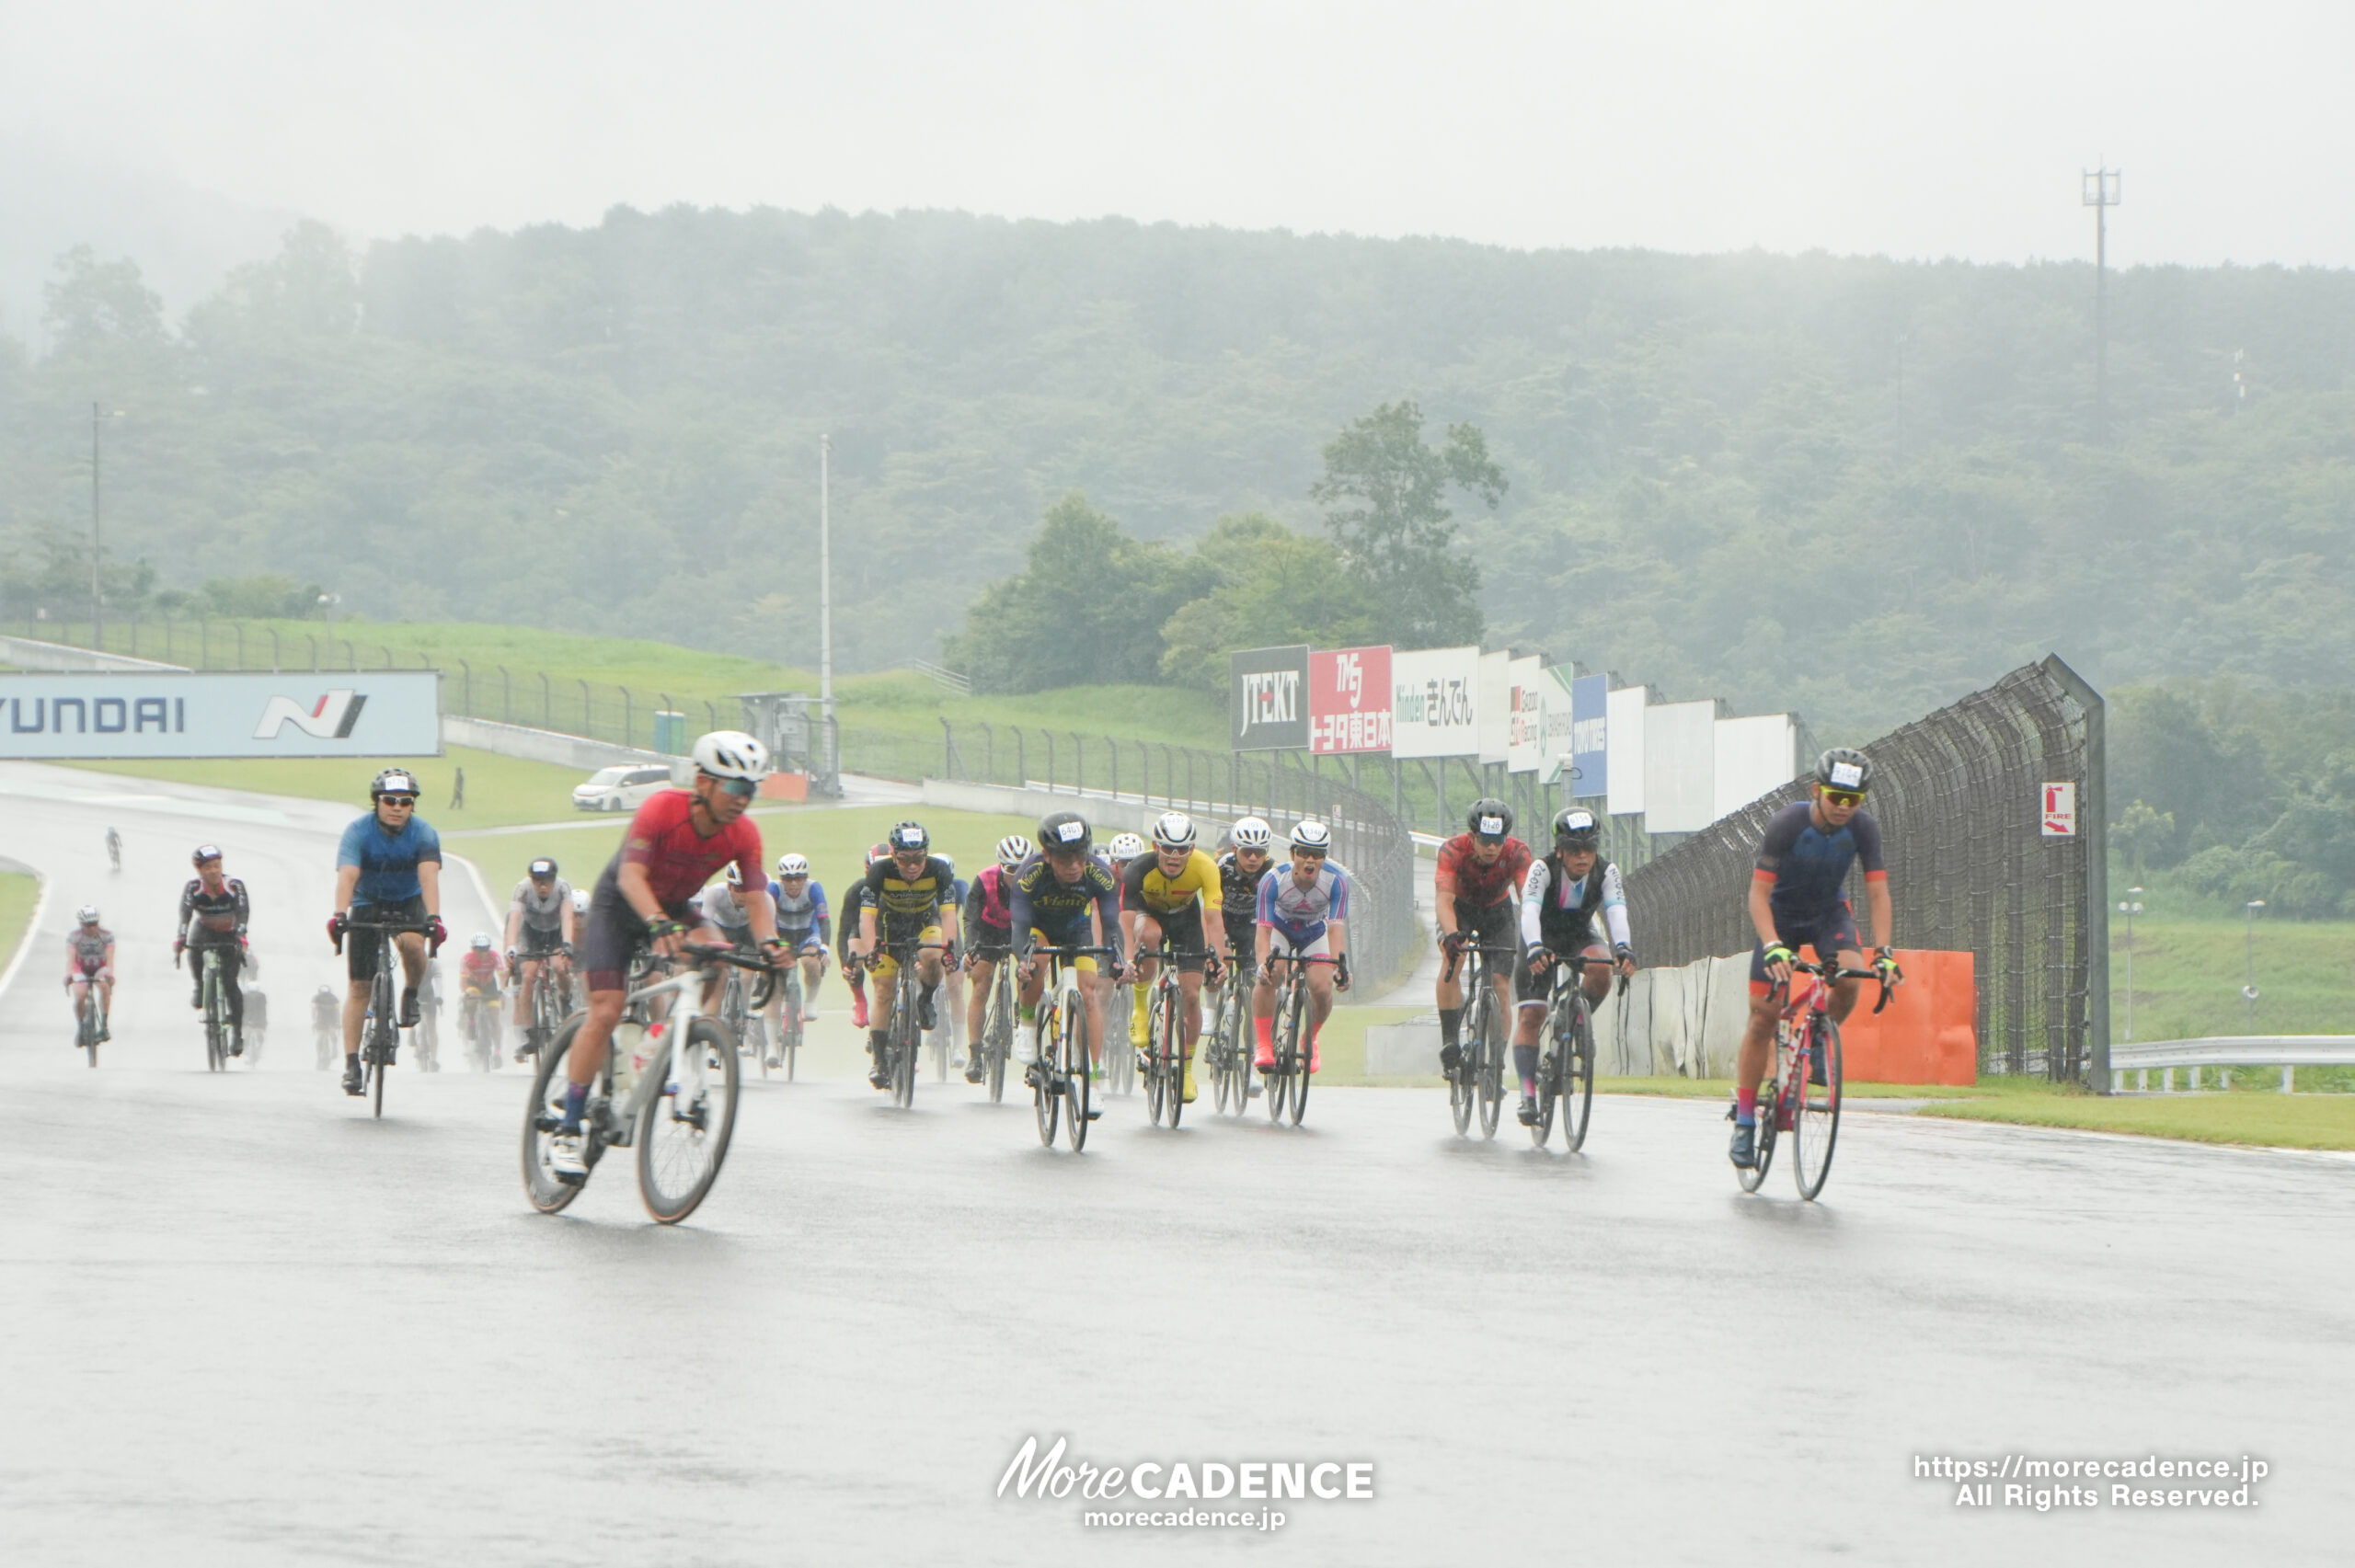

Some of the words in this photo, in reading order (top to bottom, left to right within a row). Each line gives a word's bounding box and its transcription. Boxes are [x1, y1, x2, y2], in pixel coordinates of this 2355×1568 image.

[1240, 670, 1299, 737] JTEKT
[1396, 683, 1425, 723] Kinden
[1427, 677, 1473, 727] きんでん
[1309, 709, 1391, 751] トヨタ東日本
